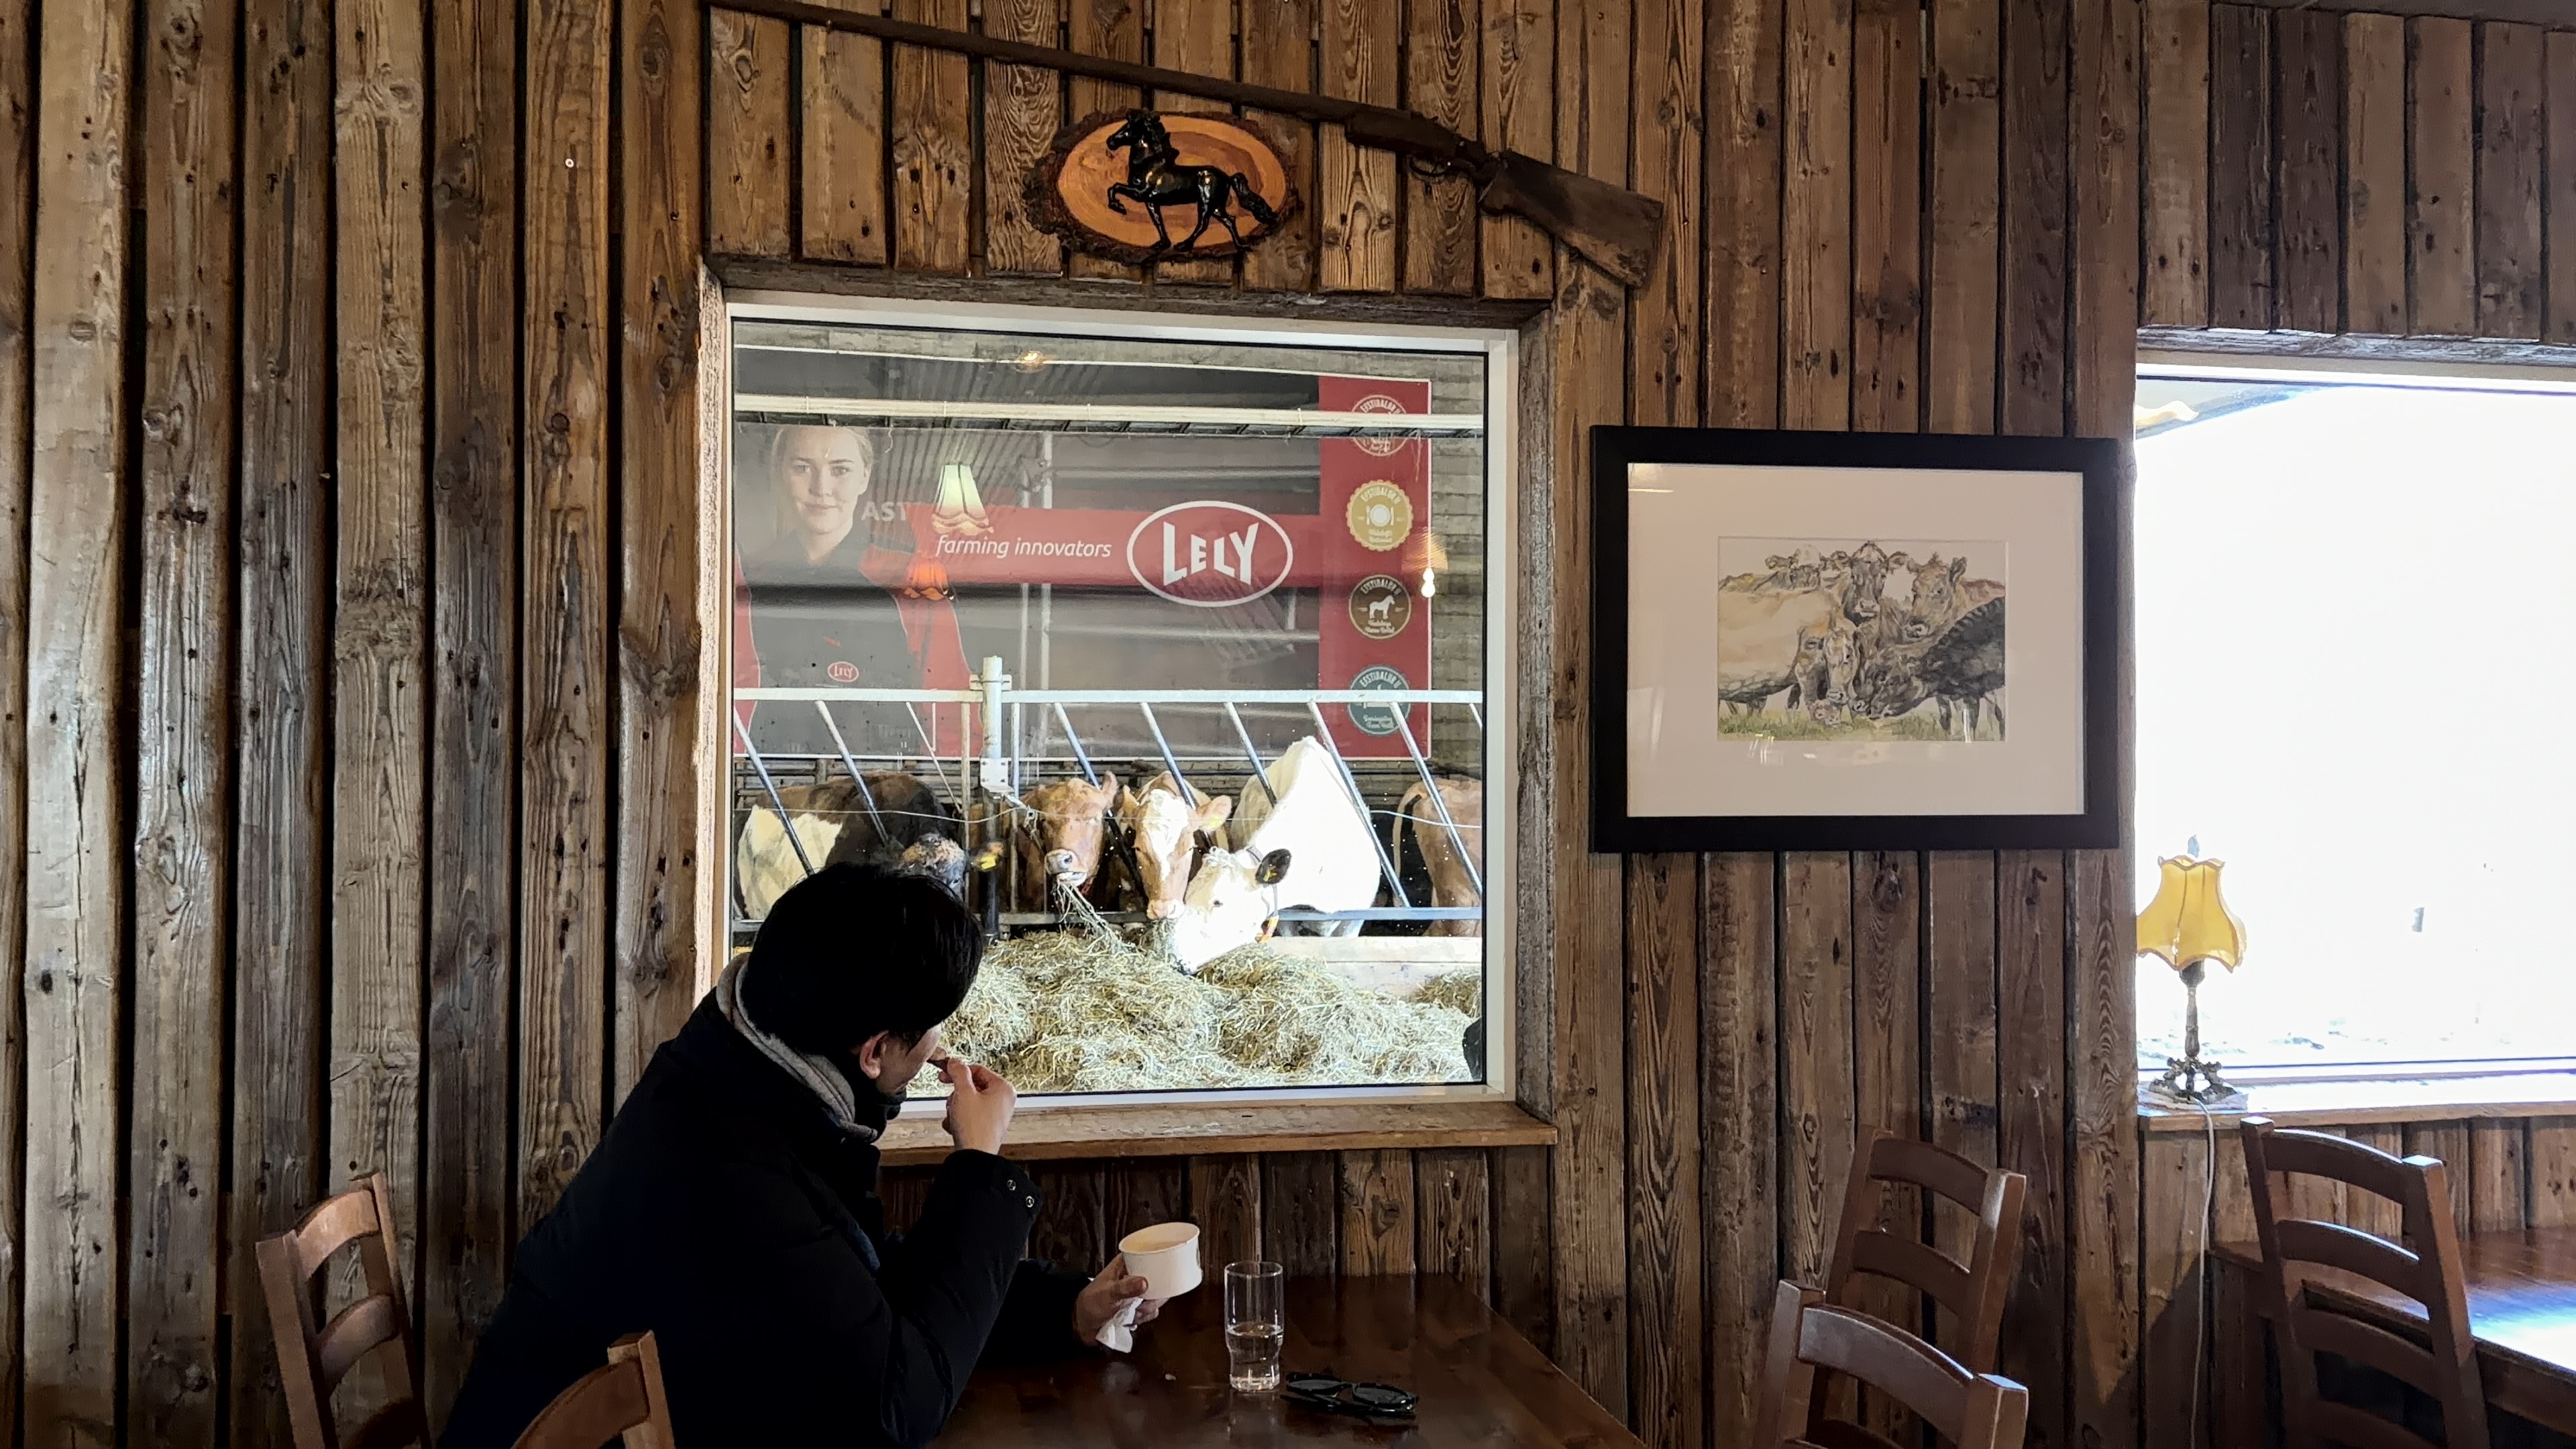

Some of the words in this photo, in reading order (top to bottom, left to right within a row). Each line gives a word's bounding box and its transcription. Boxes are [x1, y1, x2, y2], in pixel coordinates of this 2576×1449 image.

[934, 535, 1010, 558] farming
[1014, 537, 1112, 557] innovators
[1163, 521, 1260, 586] LELY
